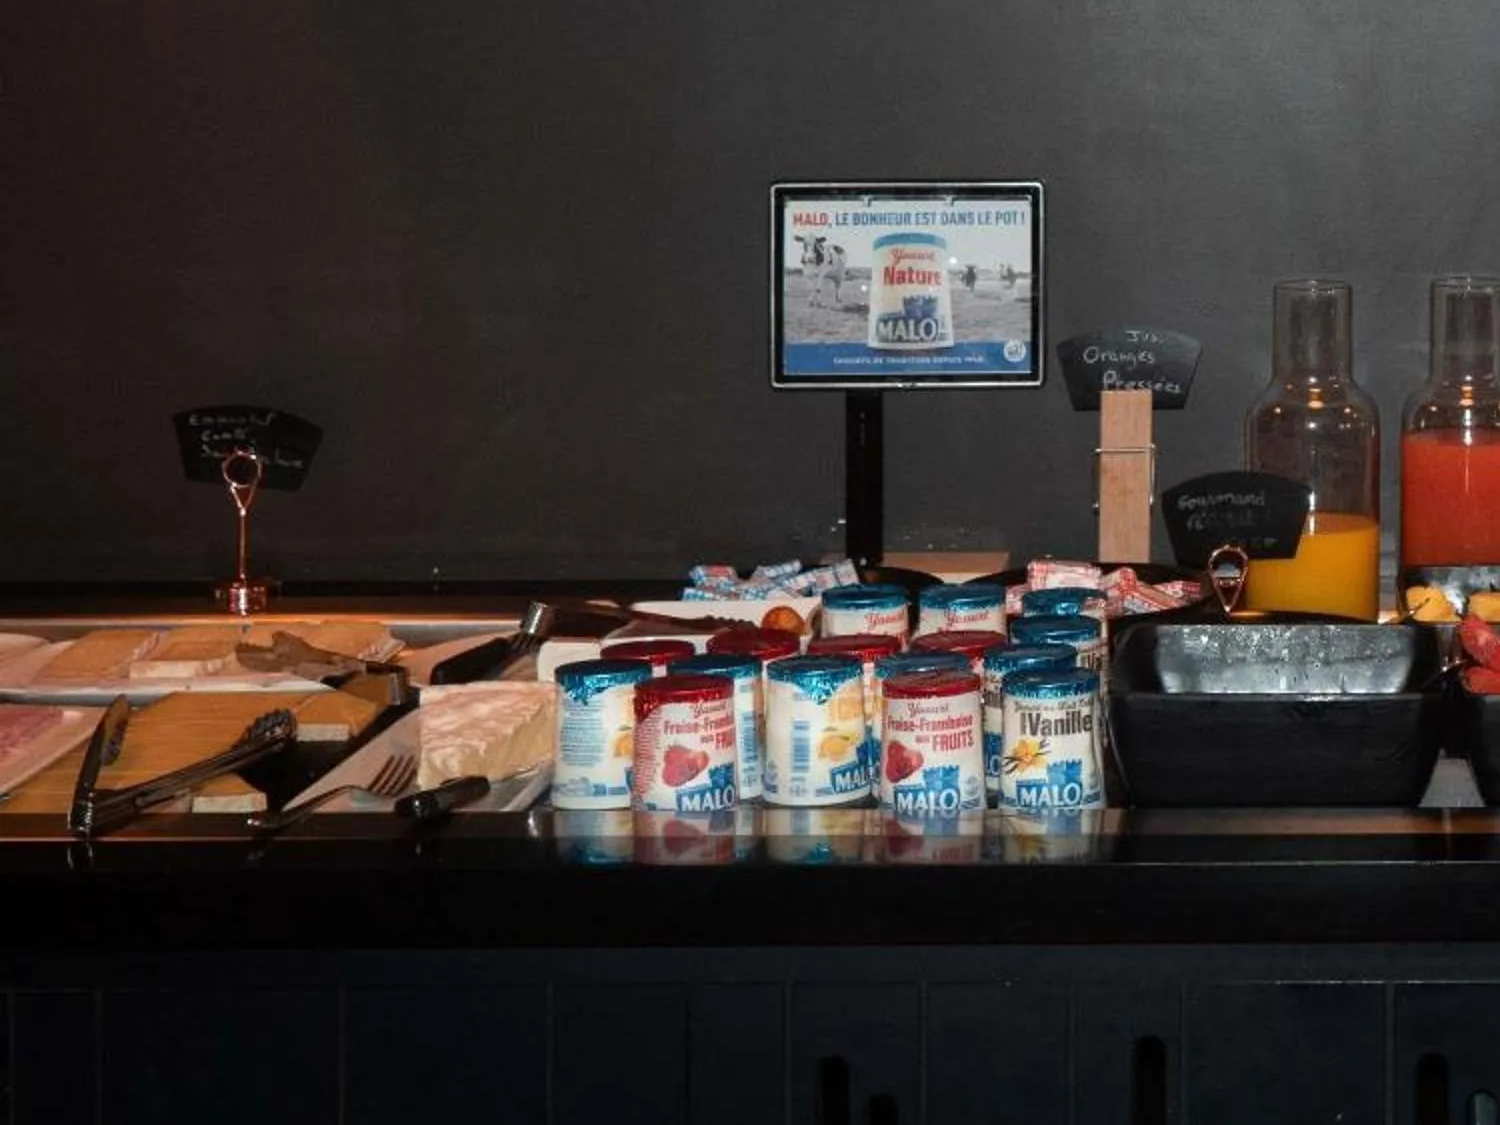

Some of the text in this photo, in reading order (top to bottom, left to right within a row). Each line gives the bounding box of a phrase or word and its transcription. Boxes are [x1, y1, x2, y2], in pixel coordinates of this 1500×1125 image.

[835, 212, 849, 226] LE
[915, 212, 936, 226] EST
[940, 211, 975, 226] DANS
[977, 210, 993, 226] LE
[995, 210, 1018, 226] POT
[879, 317, 938, 341] MALO
[932, 730, 974, 752] FRUITS
[897, 788, 960, 812] MALO
[1019, 782, 1082, 807] MALO
